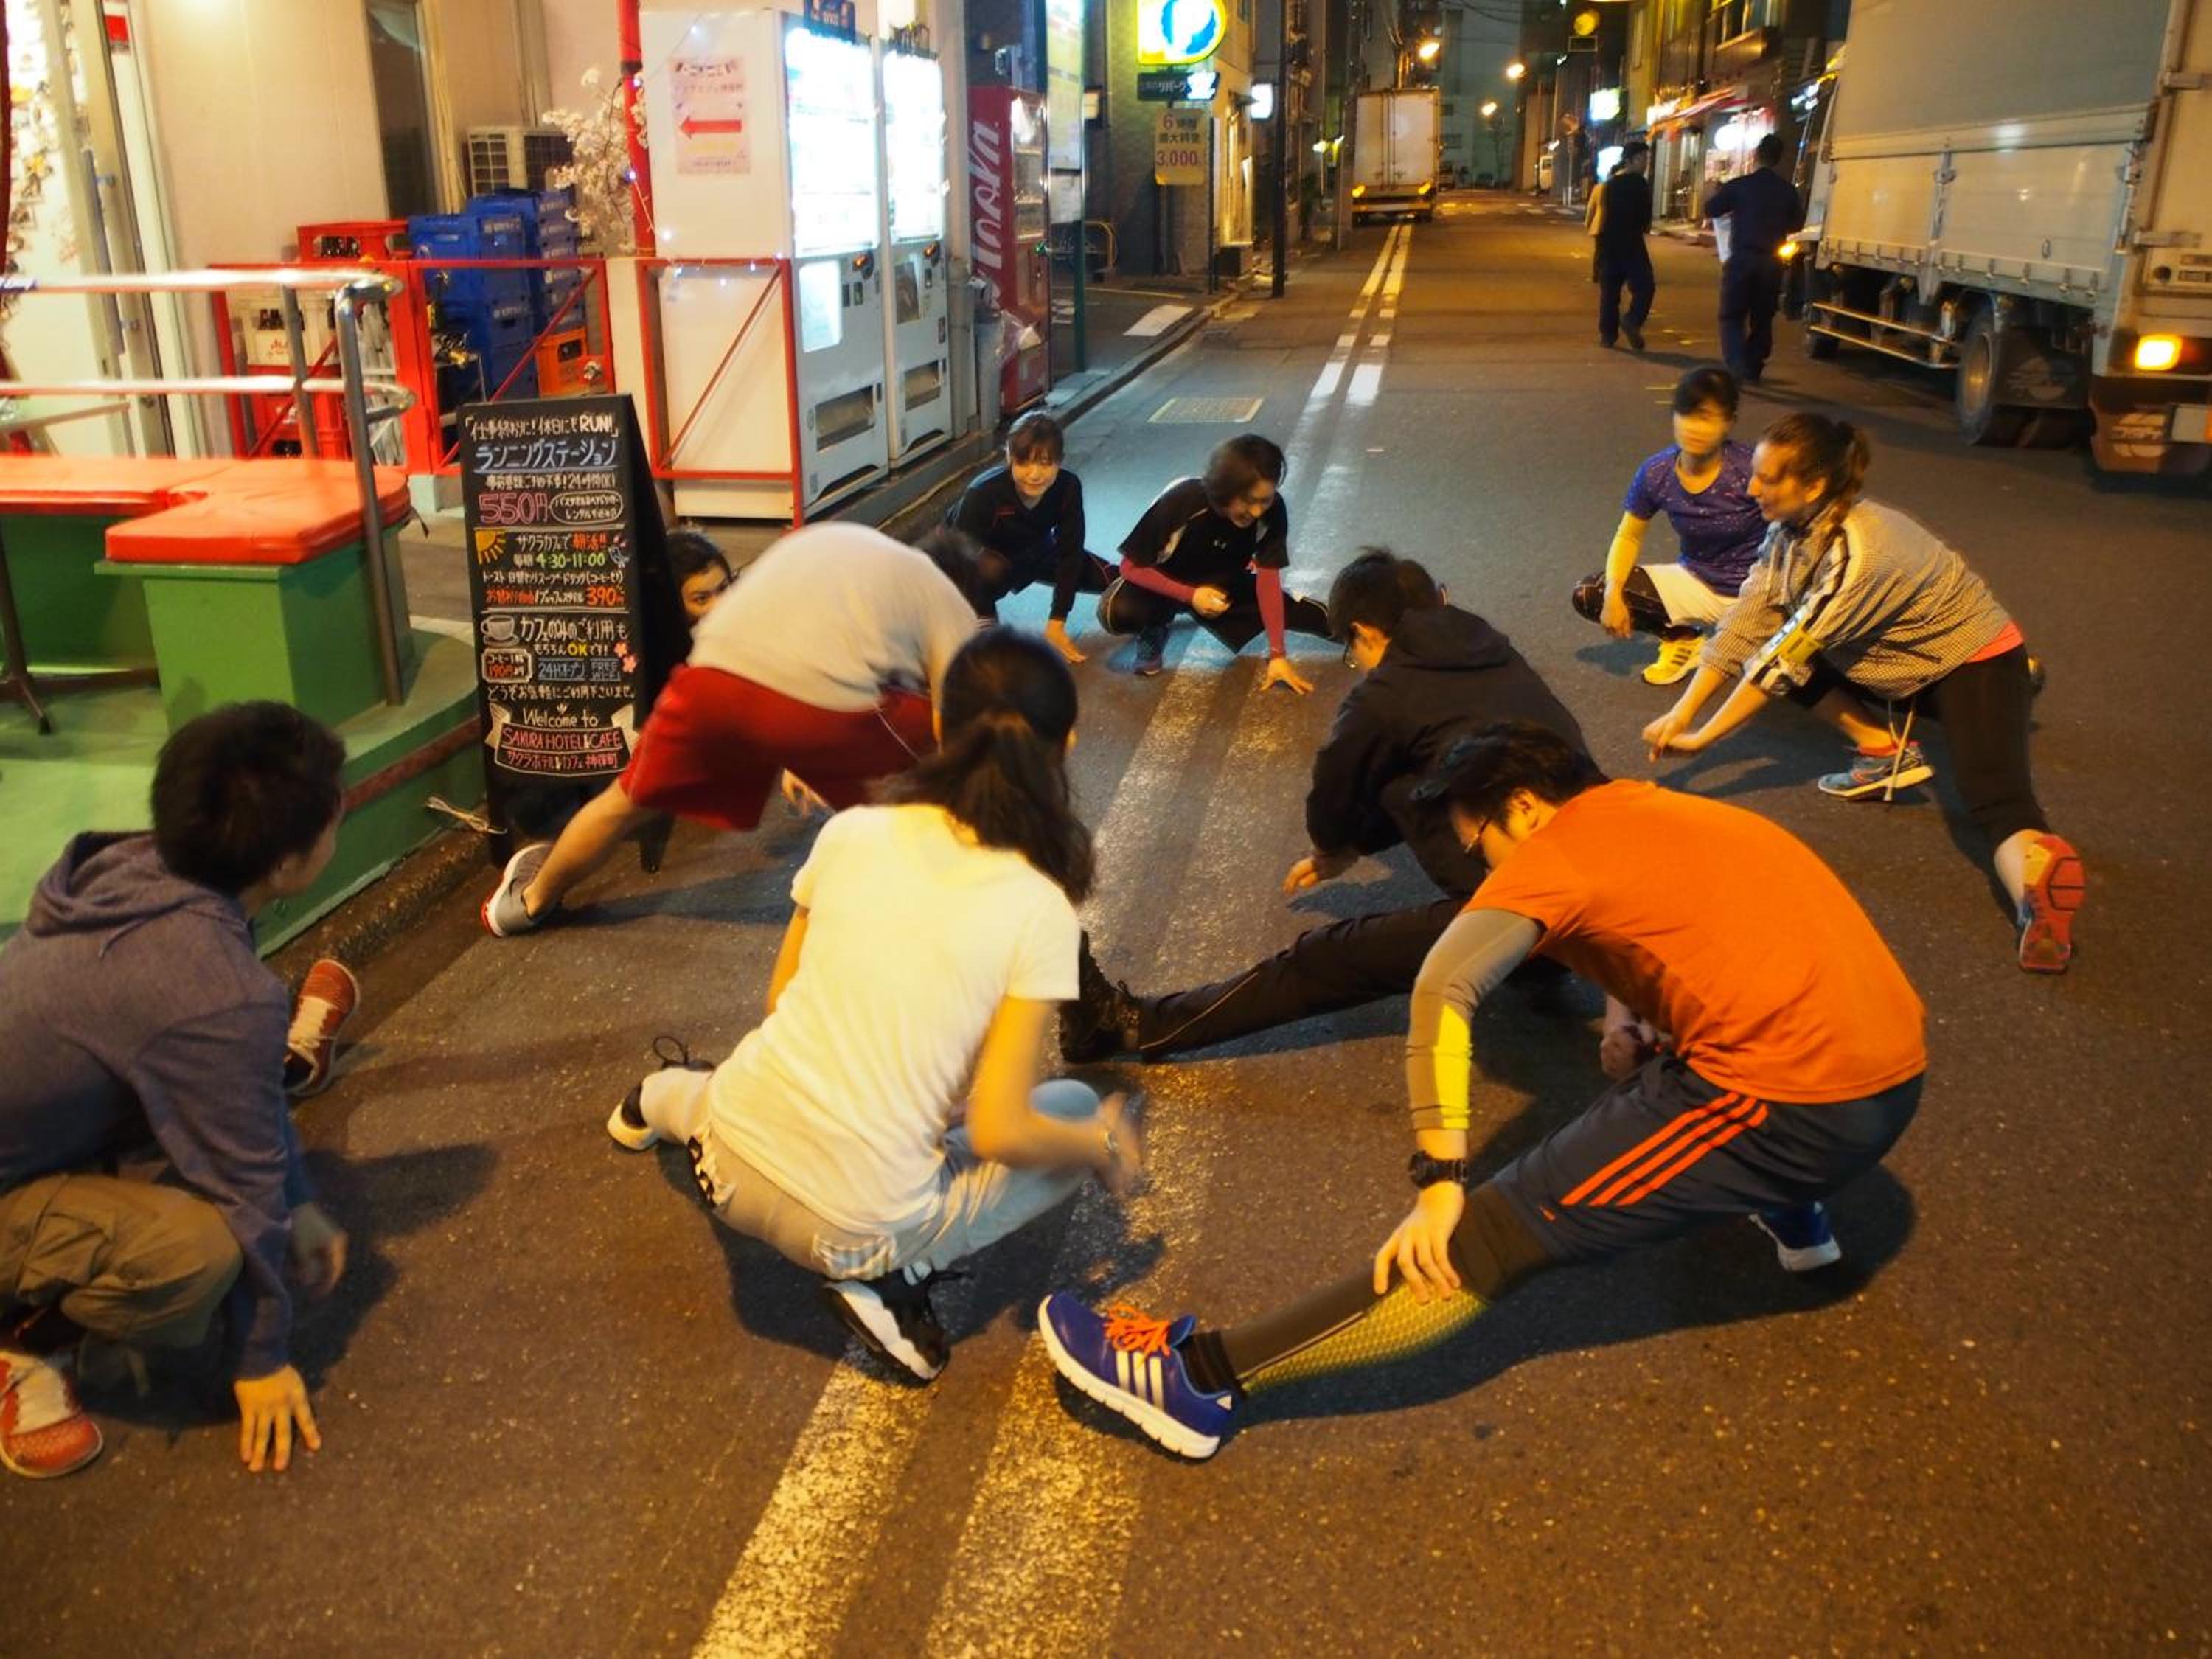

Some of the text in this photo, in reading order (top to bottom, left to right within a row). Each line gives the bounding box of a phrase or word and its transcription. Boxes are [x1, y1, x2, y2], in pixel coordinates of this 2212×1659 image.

[476, 438, 616, 470] ランニングステーション
[479, 492, 548, 524] 550円
[523, 707, 599, 728] Welcome to
[503, 726, 543, 748] SAKURA
[546, 731, 583, 749] HOTEL
